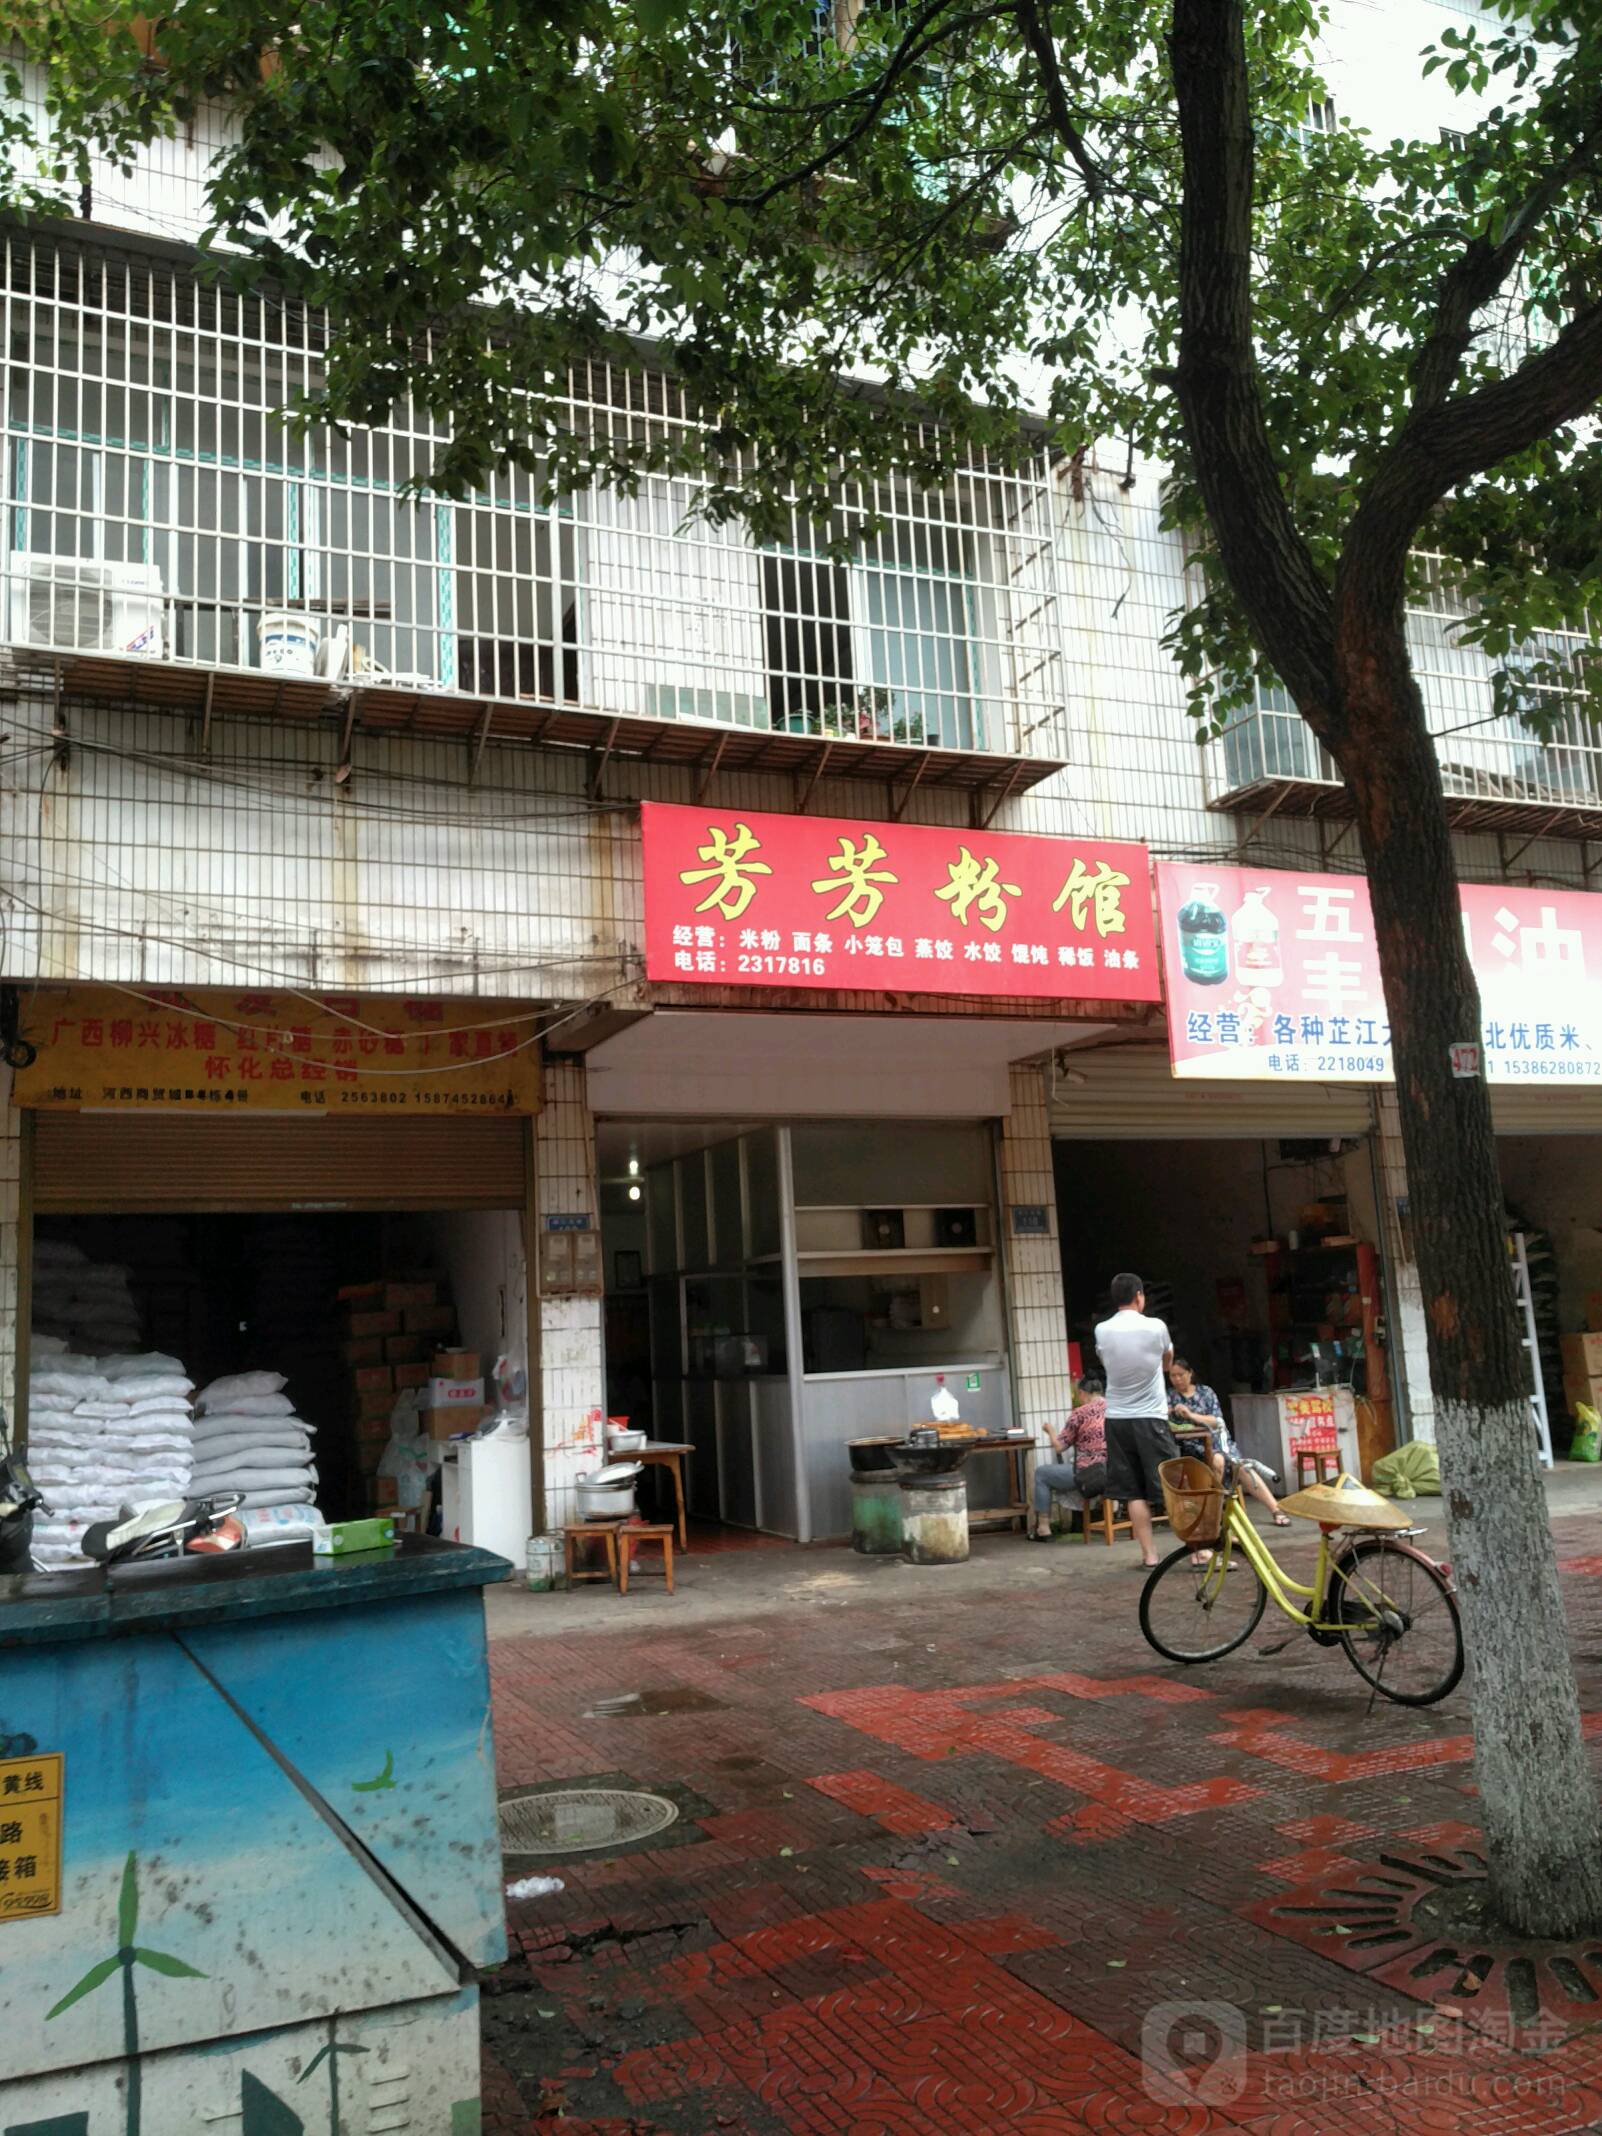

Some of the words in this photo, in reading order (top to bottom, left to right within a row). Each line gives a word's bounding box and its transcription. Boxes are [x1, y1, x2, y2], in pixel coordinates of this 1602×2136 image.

[679, 822, 1132, 938] 芳芳粉馆
[672, 924, 725, 948] 经营：
[739, 928, 781, 951] 米粉
[792, 931, 833, 954] 面条
[844, 934, 904, 957] 小笼包
[915, 938, 953, 960] 蒸饺
[964, 941, 1002, 963] 水饺
[1011, 943, 1049, 965] 馄饨
[1058, 946, 1094, 967] 稀饭
[1104, 949, 1140, 969] 油条
[674, 950, 726, 972] 电话：
[738, 954, 825, 976] 2317816
[1318, 1055, 1385, 1073] 2218049
[1504, 1060, 1601, 1076] 15386280872
